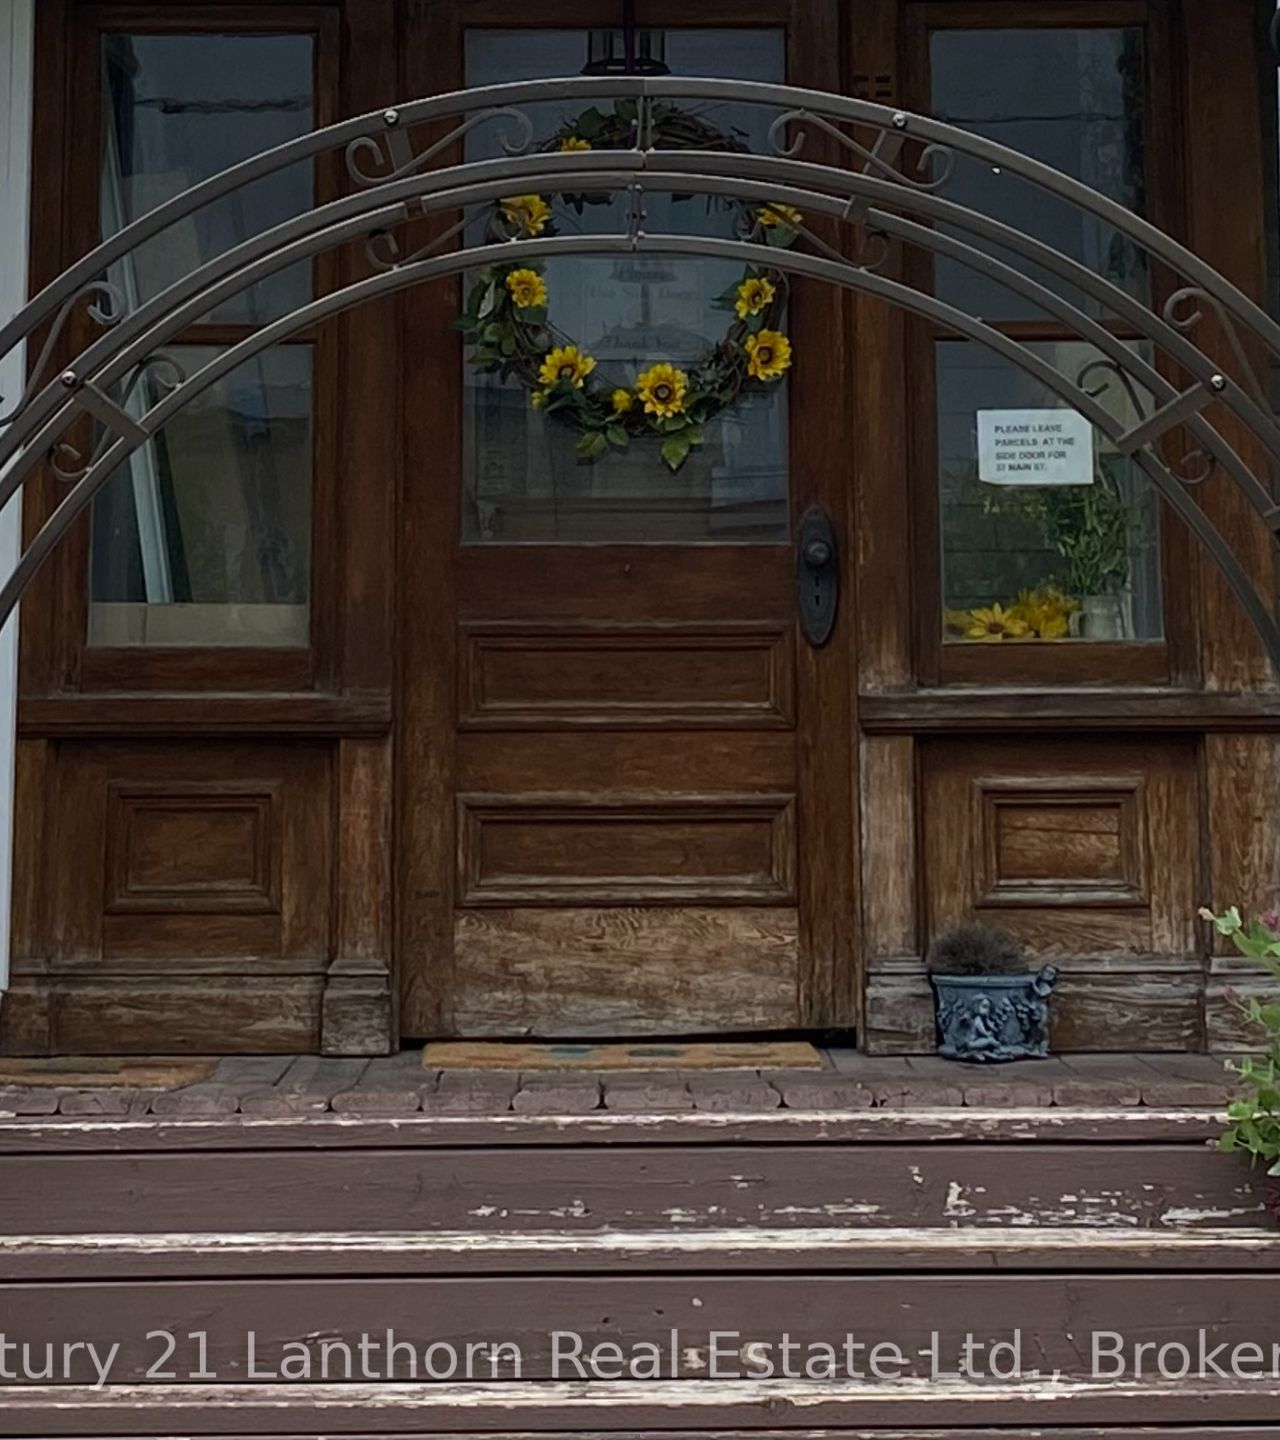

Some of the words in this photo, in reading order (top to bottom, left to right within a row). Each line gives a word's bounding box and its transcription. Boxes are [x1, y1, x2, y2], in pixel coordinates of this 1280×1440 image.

[994, 424, 1030, 434] PLEASE
[1032, 423, 1063, 433] LEAVE
[994, 438, 1039, 447] PARCELS
[1042, 437, 1055, 446] AT
[1057, 437, 1075, 446] THE
[995, 451, 1017, 460] SIDE
[1018, 451, 1046, 460] DOOR
[1047, 450, 1067, 459] FOR
[1008, 462, 1032, 471] MAIN
